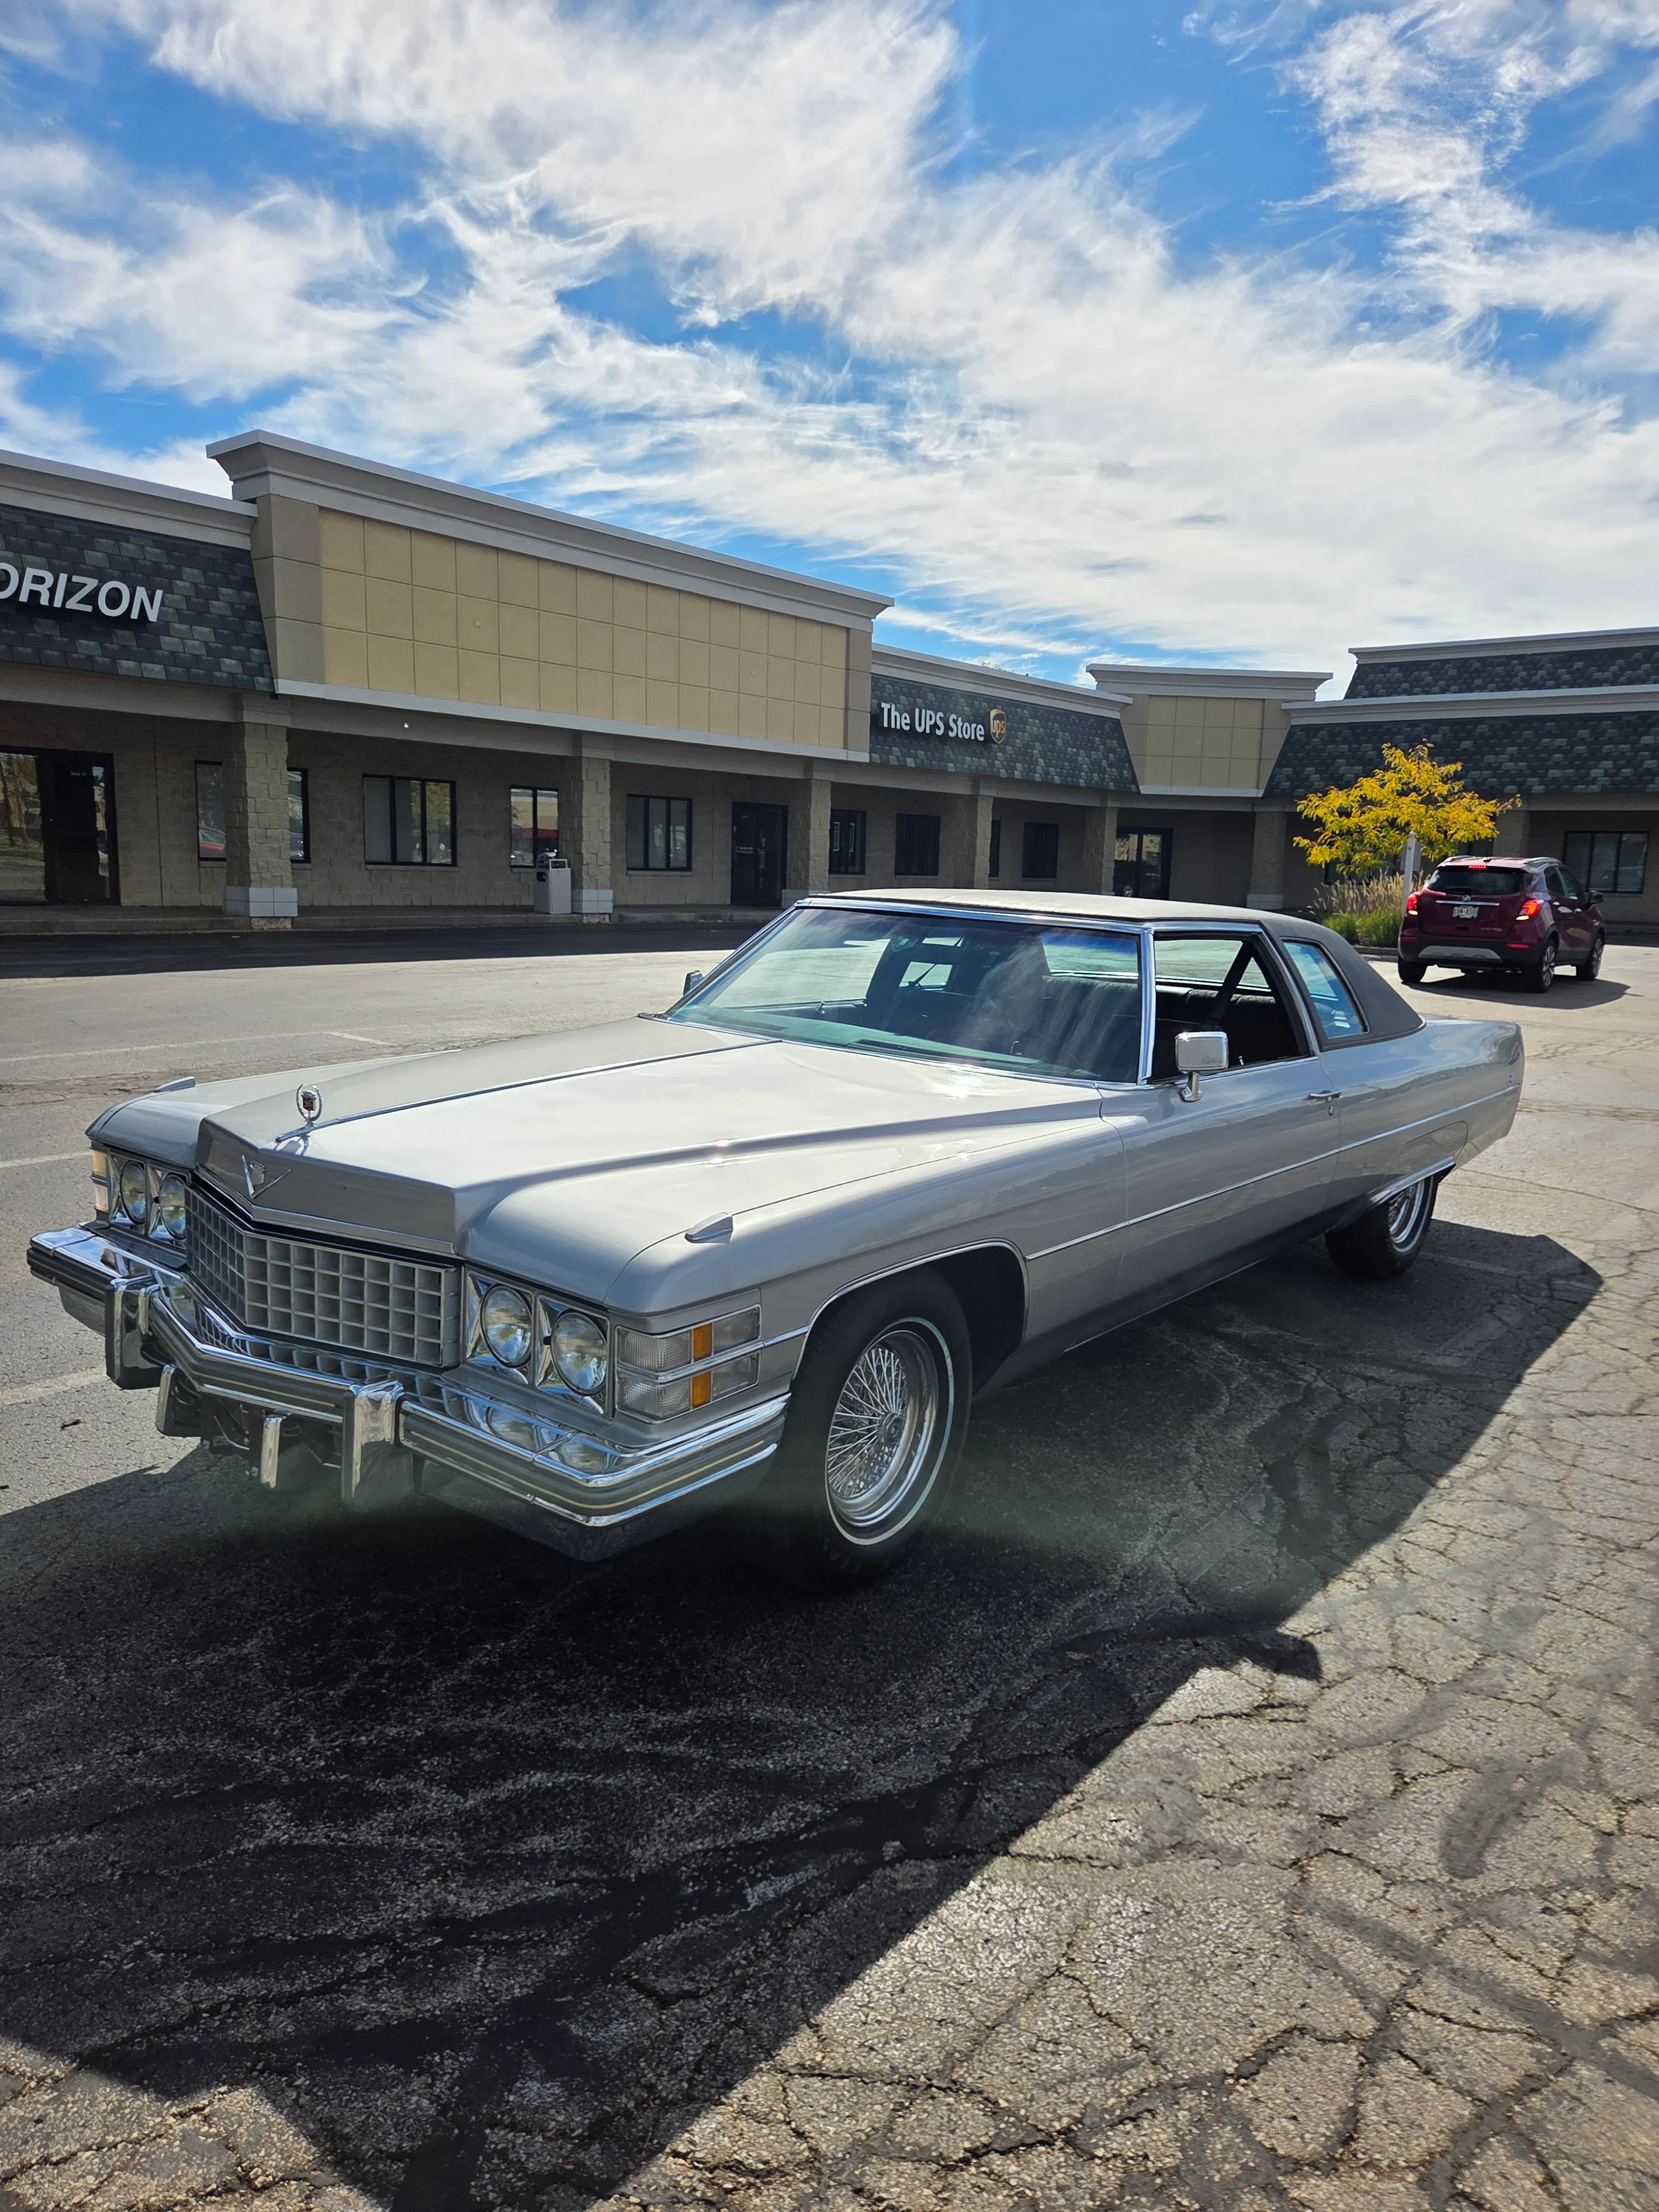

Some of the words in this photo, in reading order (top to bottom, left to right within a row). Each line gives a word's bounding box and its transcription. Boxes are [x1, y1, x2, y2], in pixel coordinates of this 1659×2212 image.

[881, 702, 910, 731] The
[915, 708, 945, 735] UPS
[948, 714, 985, 742] Store
